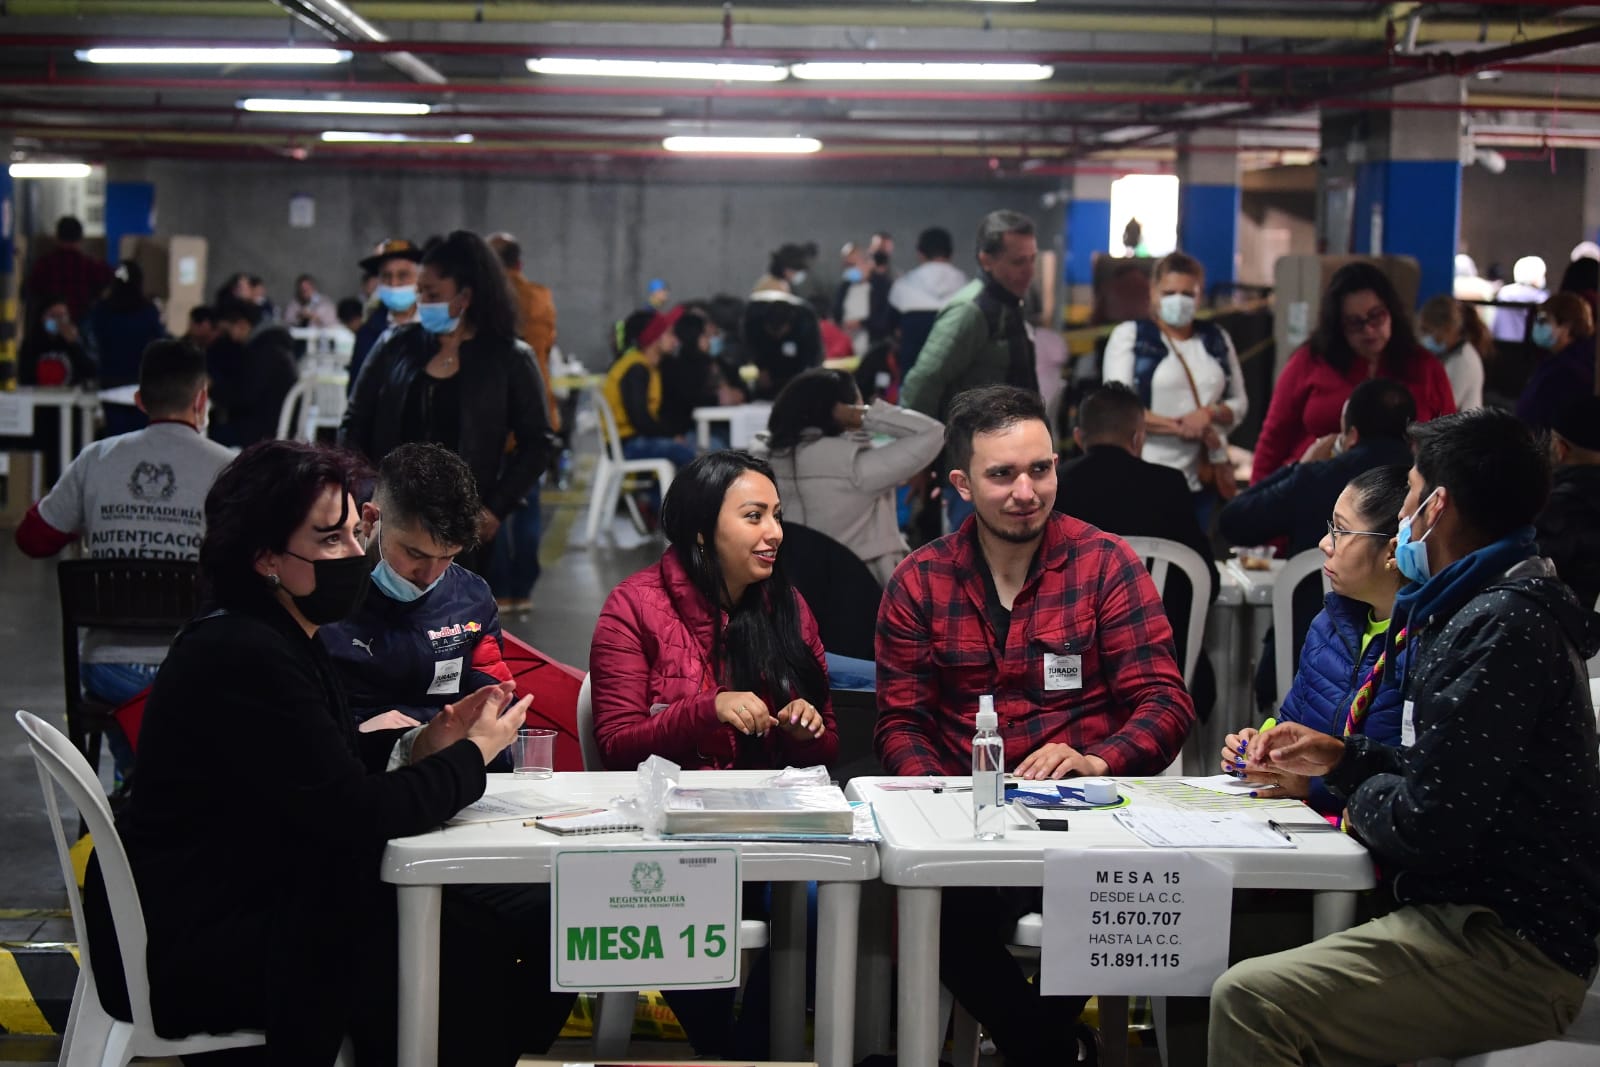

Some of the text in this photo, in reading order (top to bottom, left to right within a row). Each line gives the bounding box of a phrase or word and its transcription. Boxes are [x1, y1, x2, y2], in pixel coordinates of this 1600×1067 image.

[101, 504, 202, 519] REGISTRADURÍA
[91, 530, 202, 549] AUTENTICACIÓ
[91, 543, 200, 562] BIOMÉTRIC
[1163, 872, 1180, 884] 15
[609, 893, 686, 904] REGISTRADURÍA
[1090, 891, 1185, 903] DESDE LA C.C.
[1092, 911, 1182, 926] 51.670.707
[567, 924, 727, 961] MESA 15
[1089, 933, 1182, 945] HASTA LA C.C.
[1090, 953, 1180, 967] 51.891.115
